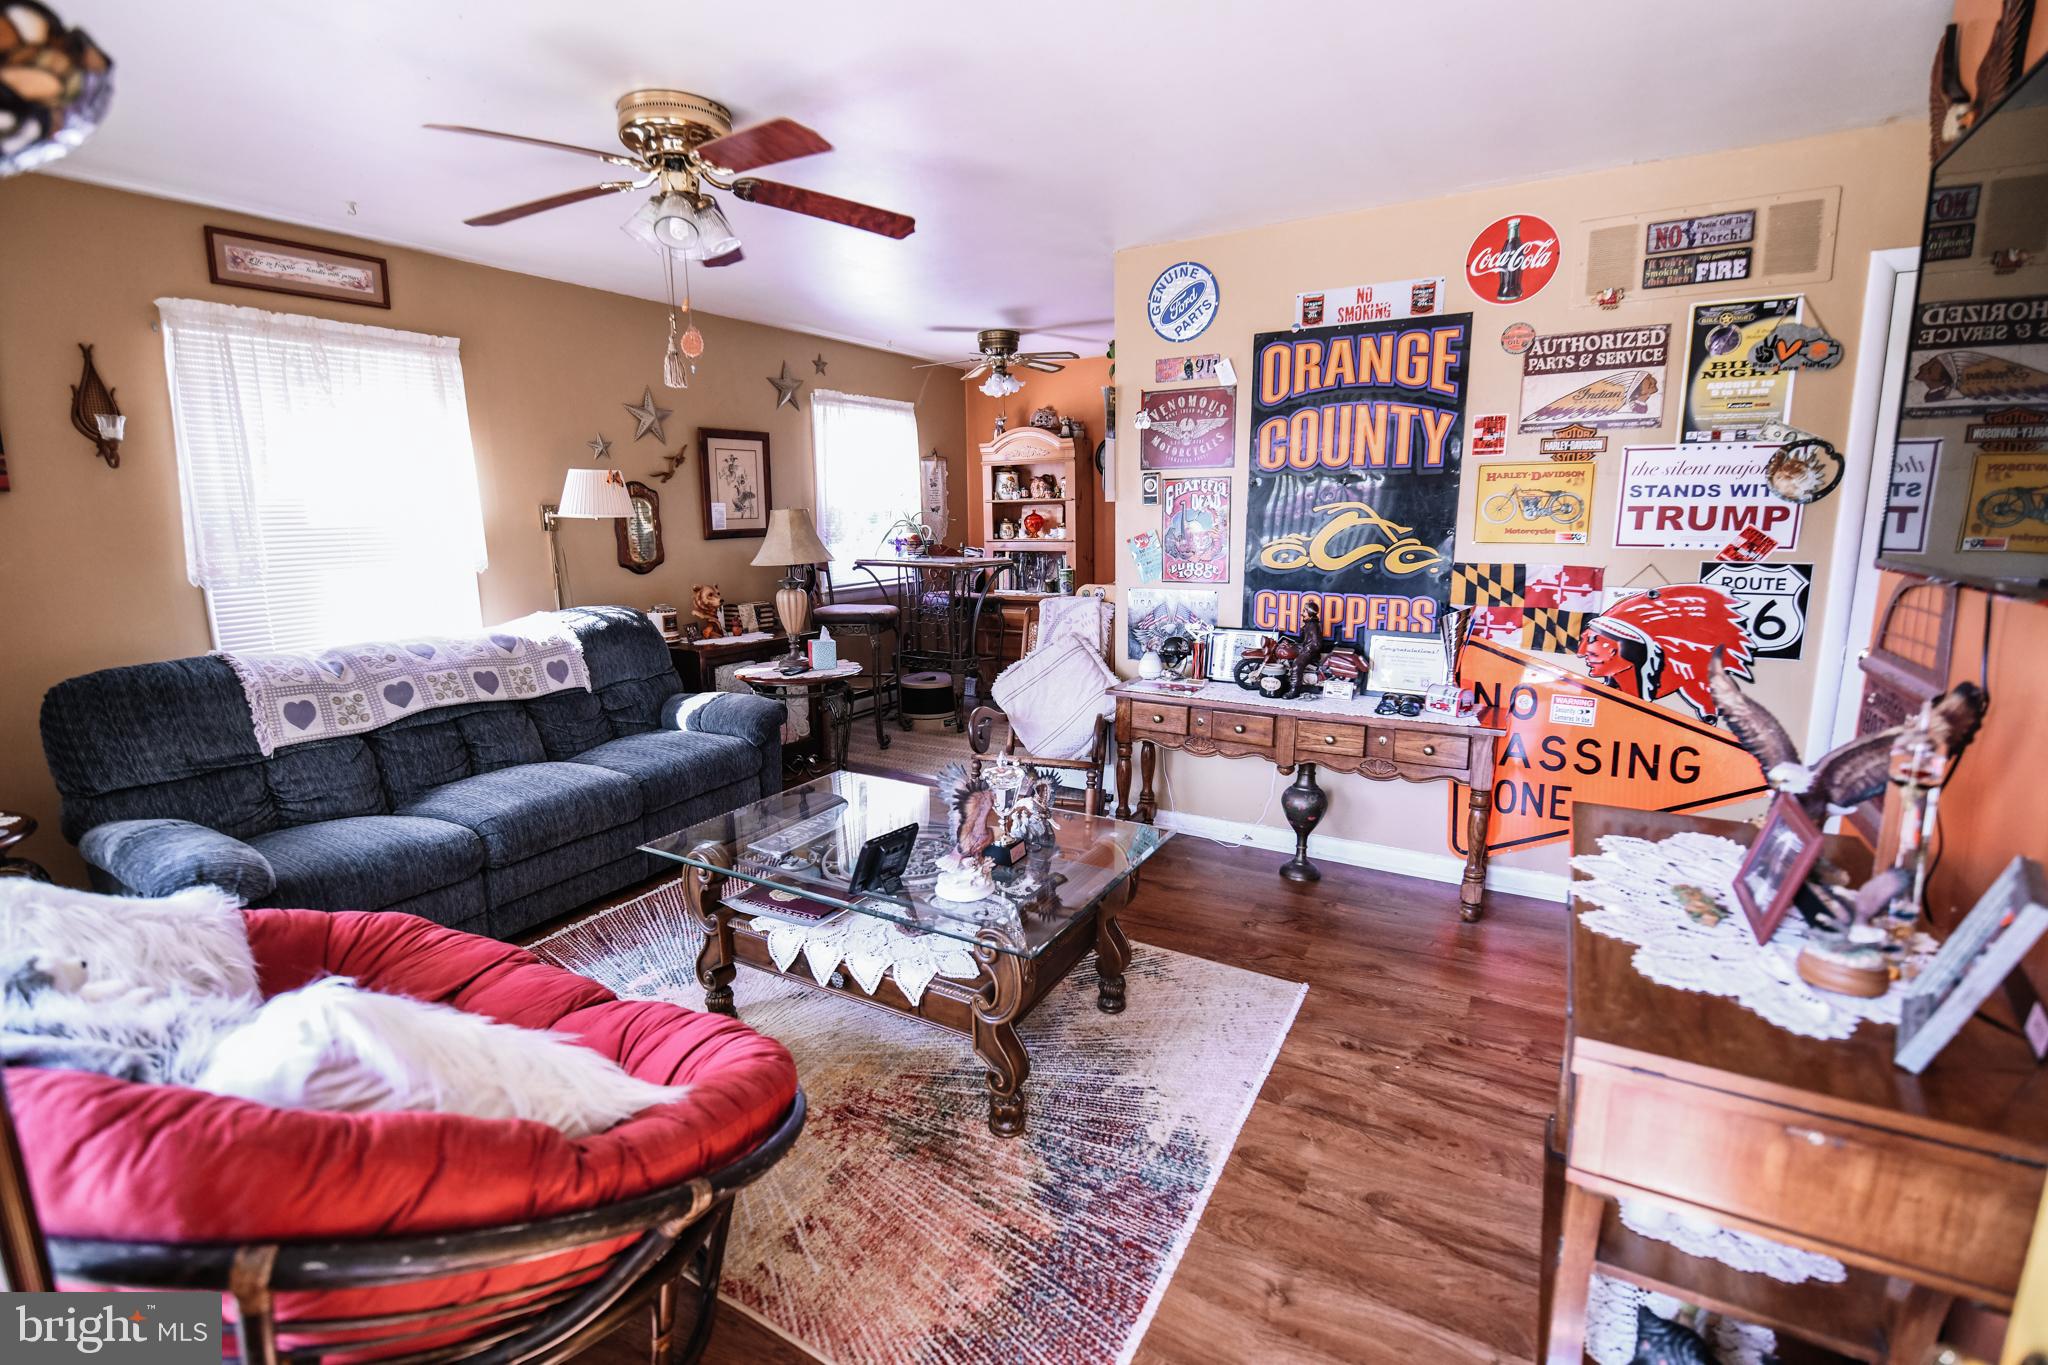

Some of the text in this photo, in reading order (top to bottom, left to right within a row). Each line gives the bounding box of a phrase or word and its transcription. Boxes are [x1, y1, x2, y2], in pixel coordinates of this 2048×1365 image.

[1654, 224, 1683, 250] NO
[1700, 228, 1743, 244] Porch!
[1695, 258, 1747, 282] FIRE
[1151, 266, 1199, 316] GENUINE
[1356, 287, 1373, 304] NO
[1169, 287, 1198, 320] Ford
[1337, 303, 1392, 323] SMOKING
[1174, 299, 1212, 337] PARTS
[1528, 329, 1666, 356] AUTHORIZED
[1261, 327, 1463, 405] ORANGE
[1527, 348, 1664, 371] PARTS & SERVICE
[1711, 360, 1749, 370] BI
[1572, 388, 1622, 401] Indian
[1149, 395, 1228, 421] VENOMOUS
[1151, 432, 1225, 457] MOTORCYCLES
[1258, 402, 1456, 470] COUNTY
[1559, 429, 1592, 438] MOTOR
[1556, 452, 1590, 461] CYCLES
[1631, 460, 1768, 480] the silent major
[1165, 479, 1230, 516] GRATEFUL
[1191, 493, 1222, 511] DEAD
[1629, 484, 1770, 498] STANDS WIT
[1627, 505, 1791, 531] TRUMP
[1504, 527, 1556, 535] Motorcycles
[1169, 561, 1220, 574] EUROPE
[1721, 576, 1787, 591] ROUTE
[1473, 681, 1538, 720] NO
[1555, 697, 1595, 707] WARNING
[1499, 732, 1701, 784] ASSING
[1494, 779, 1572, 821] ONE
